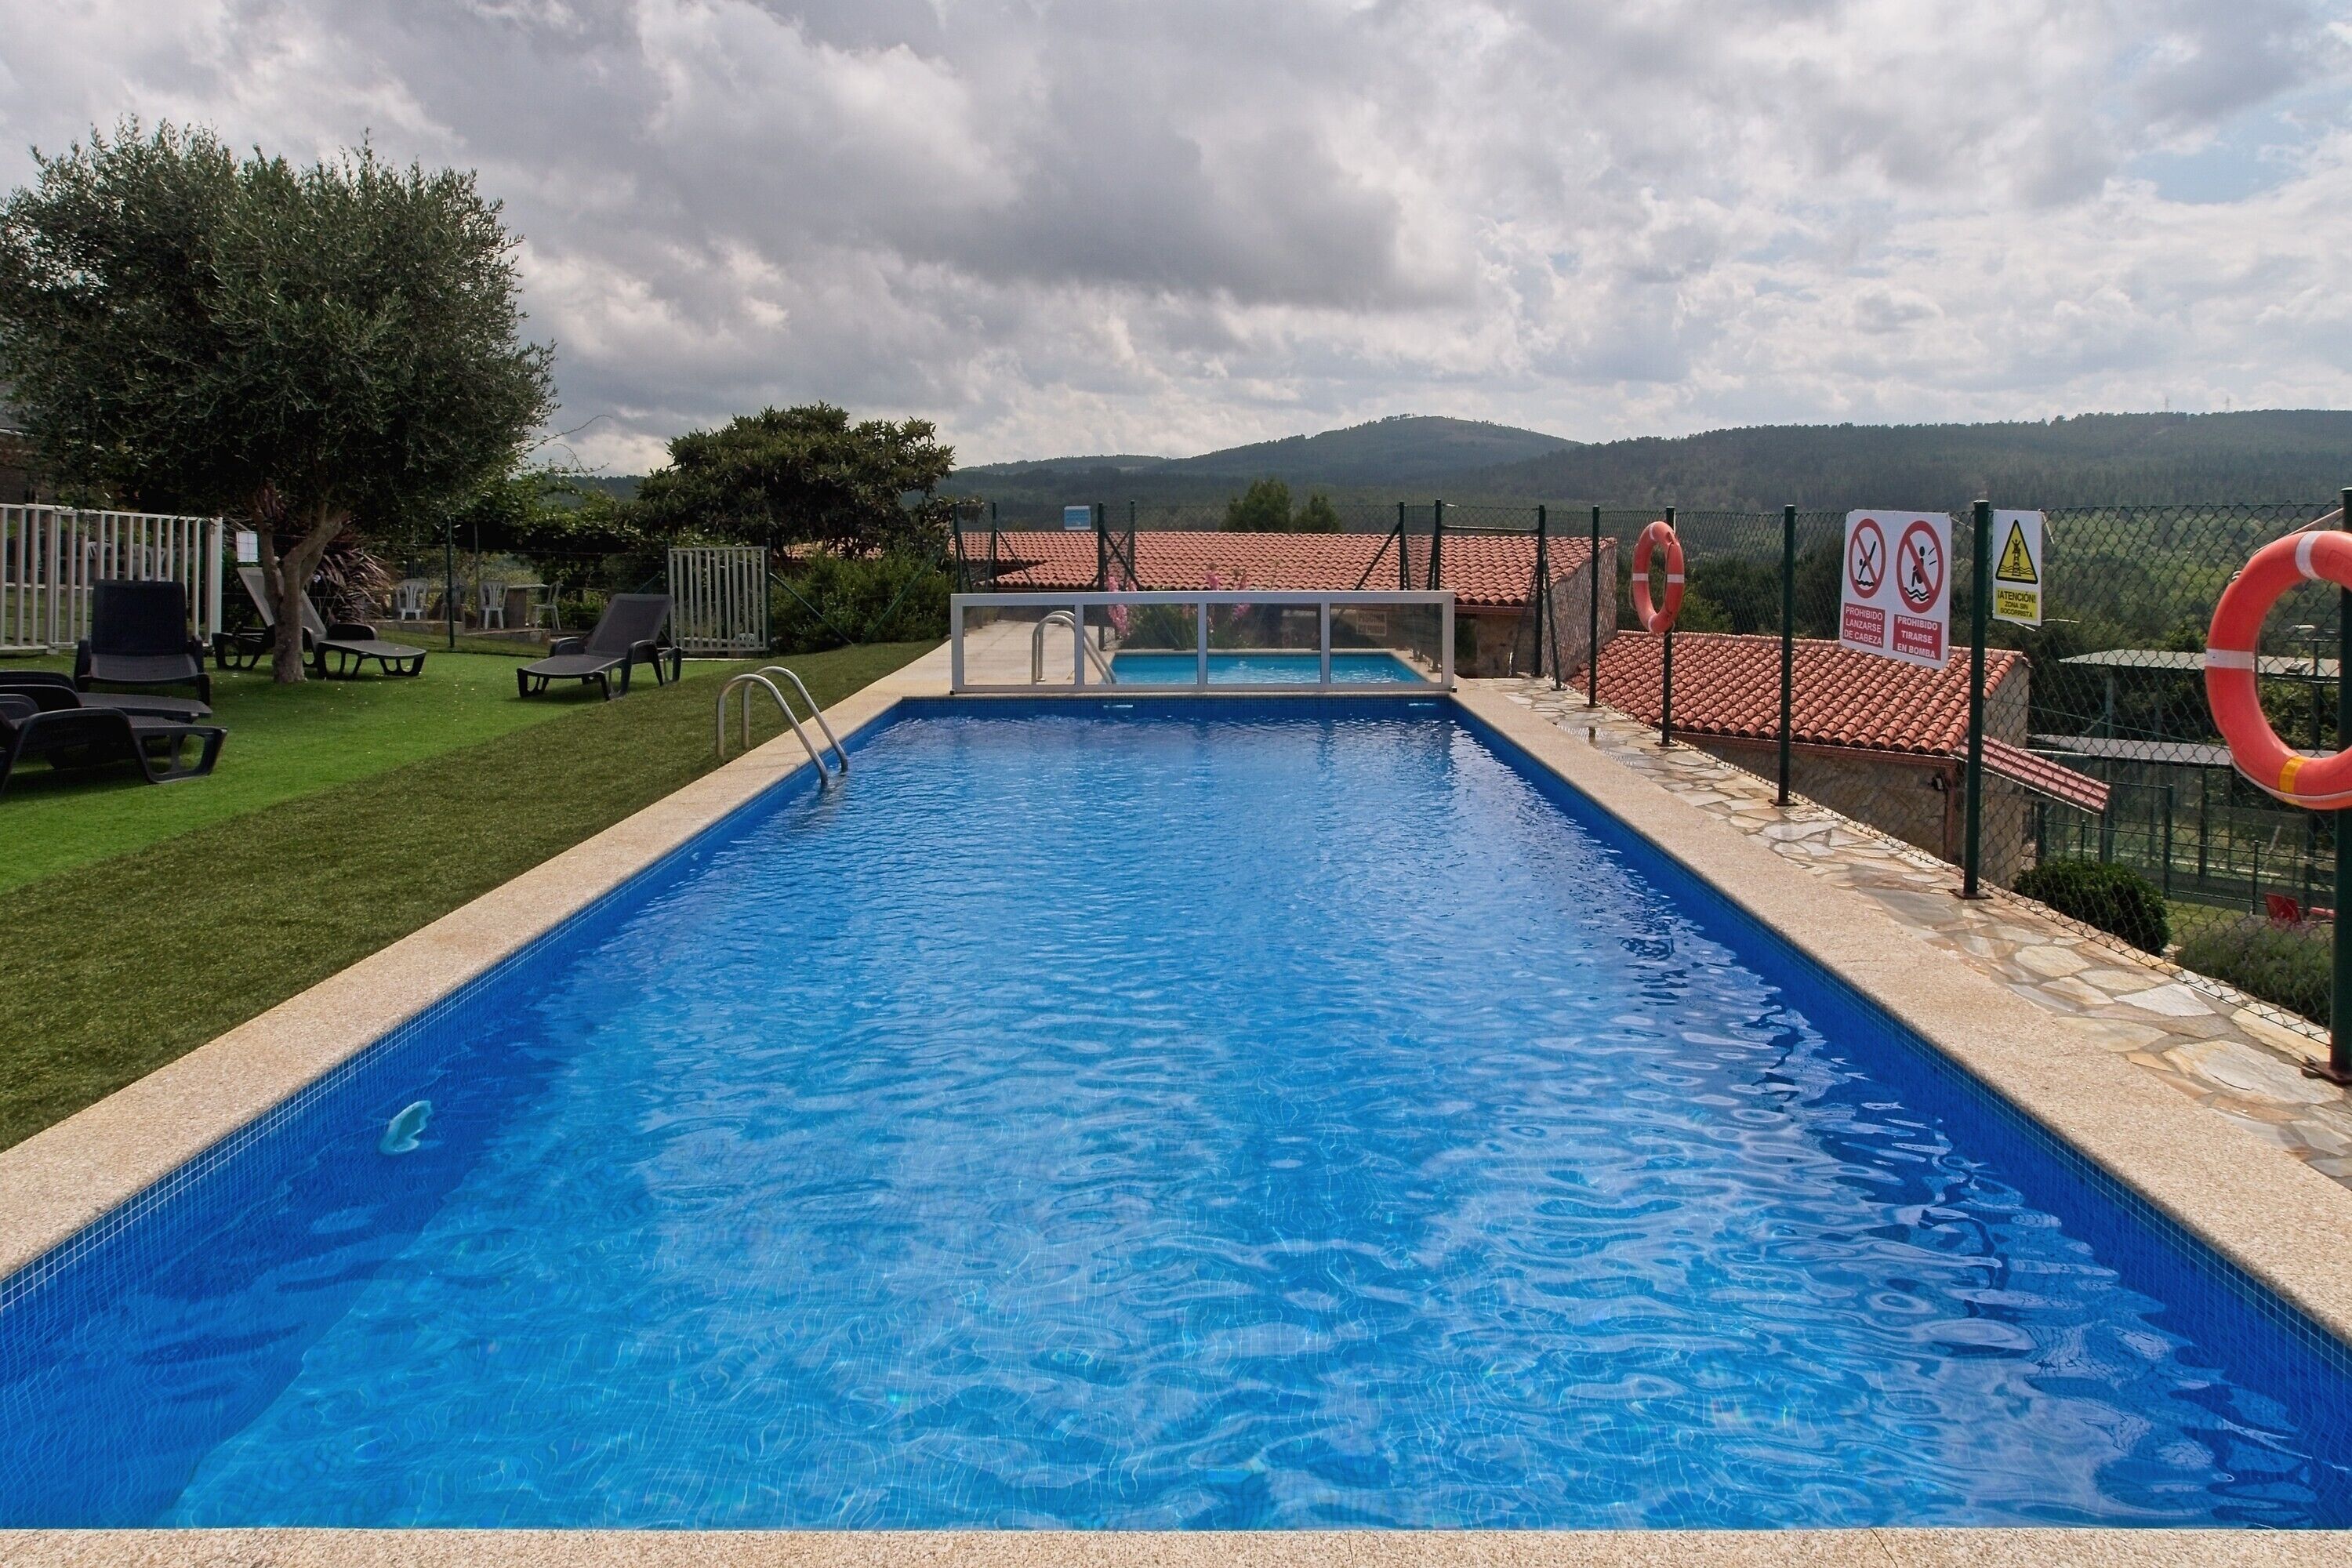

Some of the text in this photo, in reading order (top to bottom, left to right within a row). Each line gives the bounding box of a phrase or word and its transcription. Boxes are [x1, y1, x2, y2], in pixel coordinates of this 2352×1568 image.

[1846, 606, 1882, 620] PROHIBIDO
[1846, 618, 1882, 633] LANZARSE
[1897, 616, 1938, 630] PROHIBIDO
[1844, 629, 1882, 644] DE CABEZA
[1901, 630, 1933, 644] TIRARSE
[1897, 643, 1936, 659] EN BOMBA
